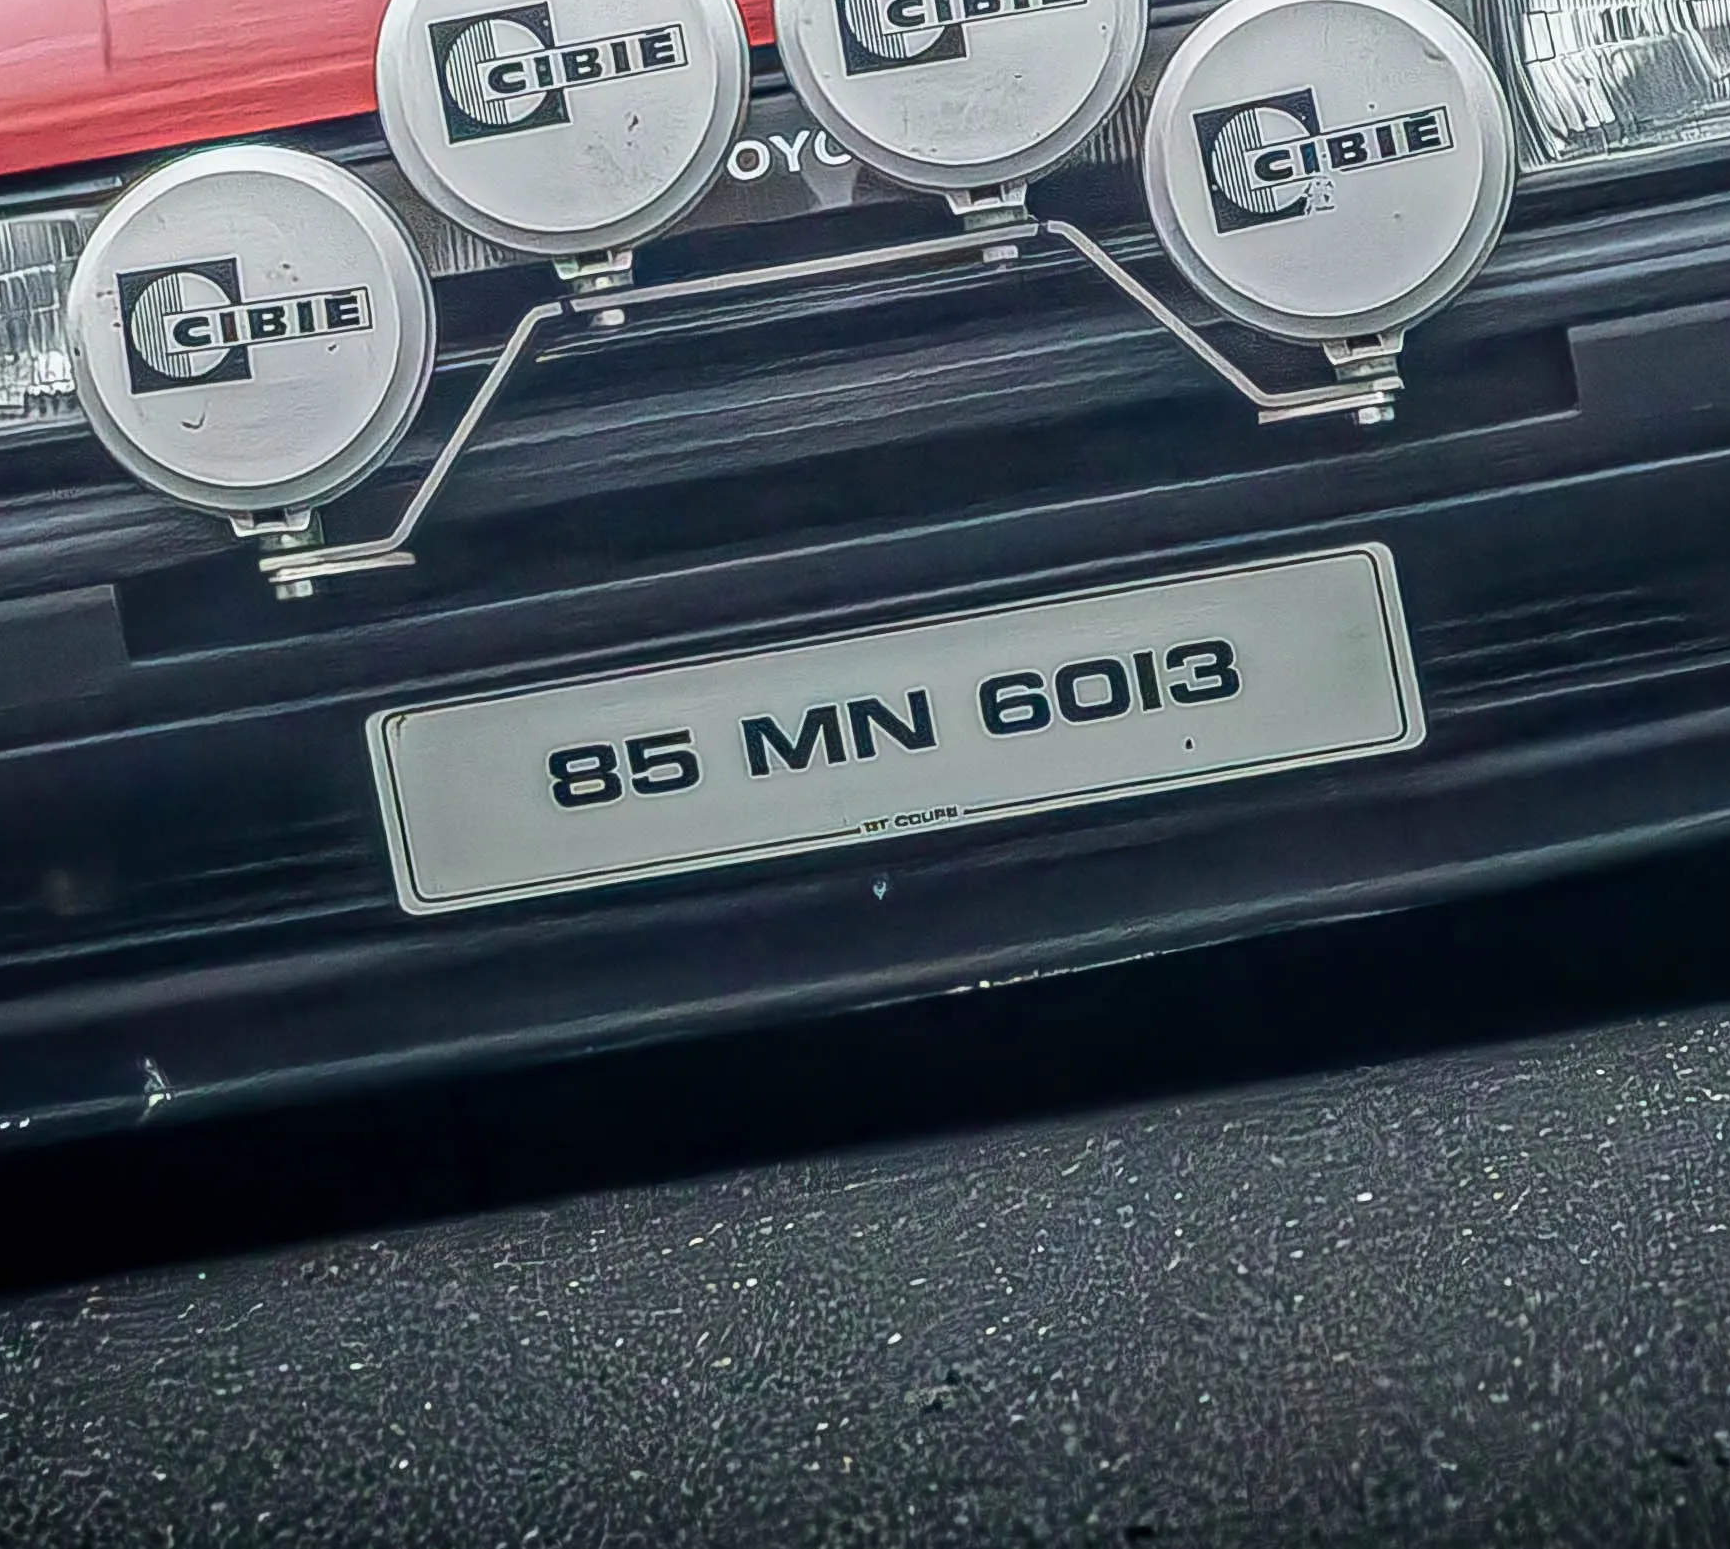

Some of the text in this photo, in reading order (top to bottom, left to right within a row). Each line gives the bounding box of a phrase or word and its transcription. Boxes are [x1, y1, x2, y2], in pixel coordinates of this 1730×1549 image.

[487, 26, 680, 94] CIBIE
[1254, 113, 1446, 181] CIBIE
[171, 286, 364, 349] CIBIE
[547, 638, 1243, 810] 85 MN 6013
